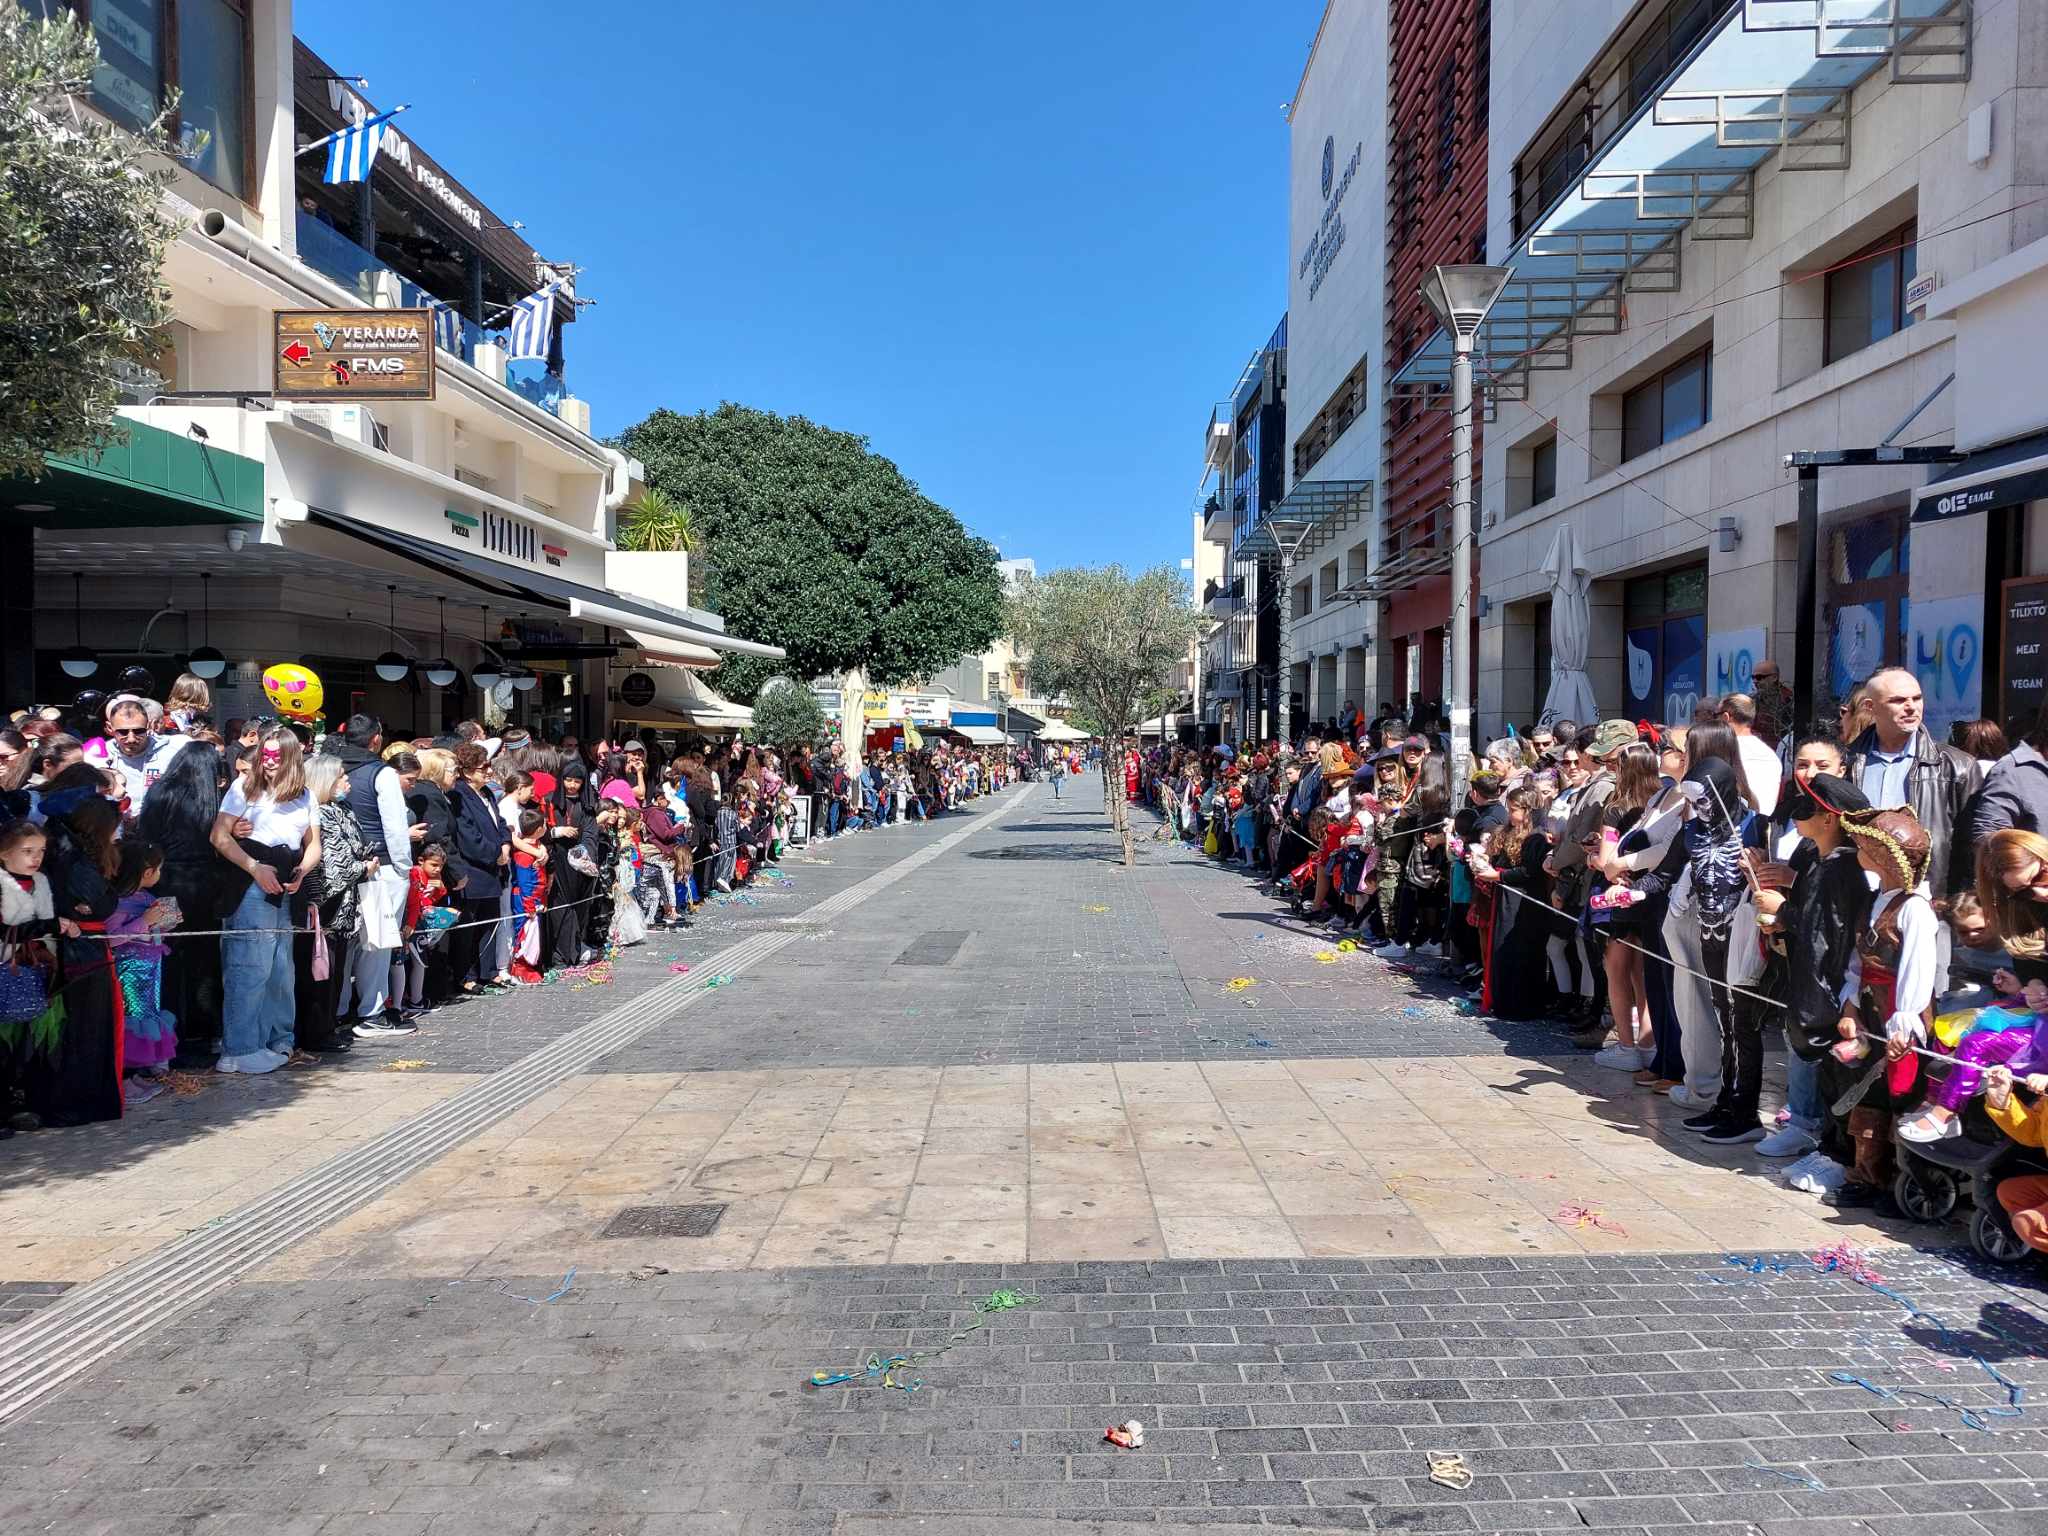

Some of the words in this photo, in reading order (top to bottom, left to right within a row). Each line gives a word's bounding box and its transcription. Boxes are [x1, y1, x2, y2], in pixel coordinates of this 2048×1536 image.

[328, 79, 413, 173] VERNDA
[342, 326, 420, 339] VERANDA
[352, 357, 405, 372] FMS
[1937, 493, 1968, 514] ΦΙΞ
[2010, 606, 2047, 619] TILIXTO
[2011, 678, 2043, 690] VEGAN
